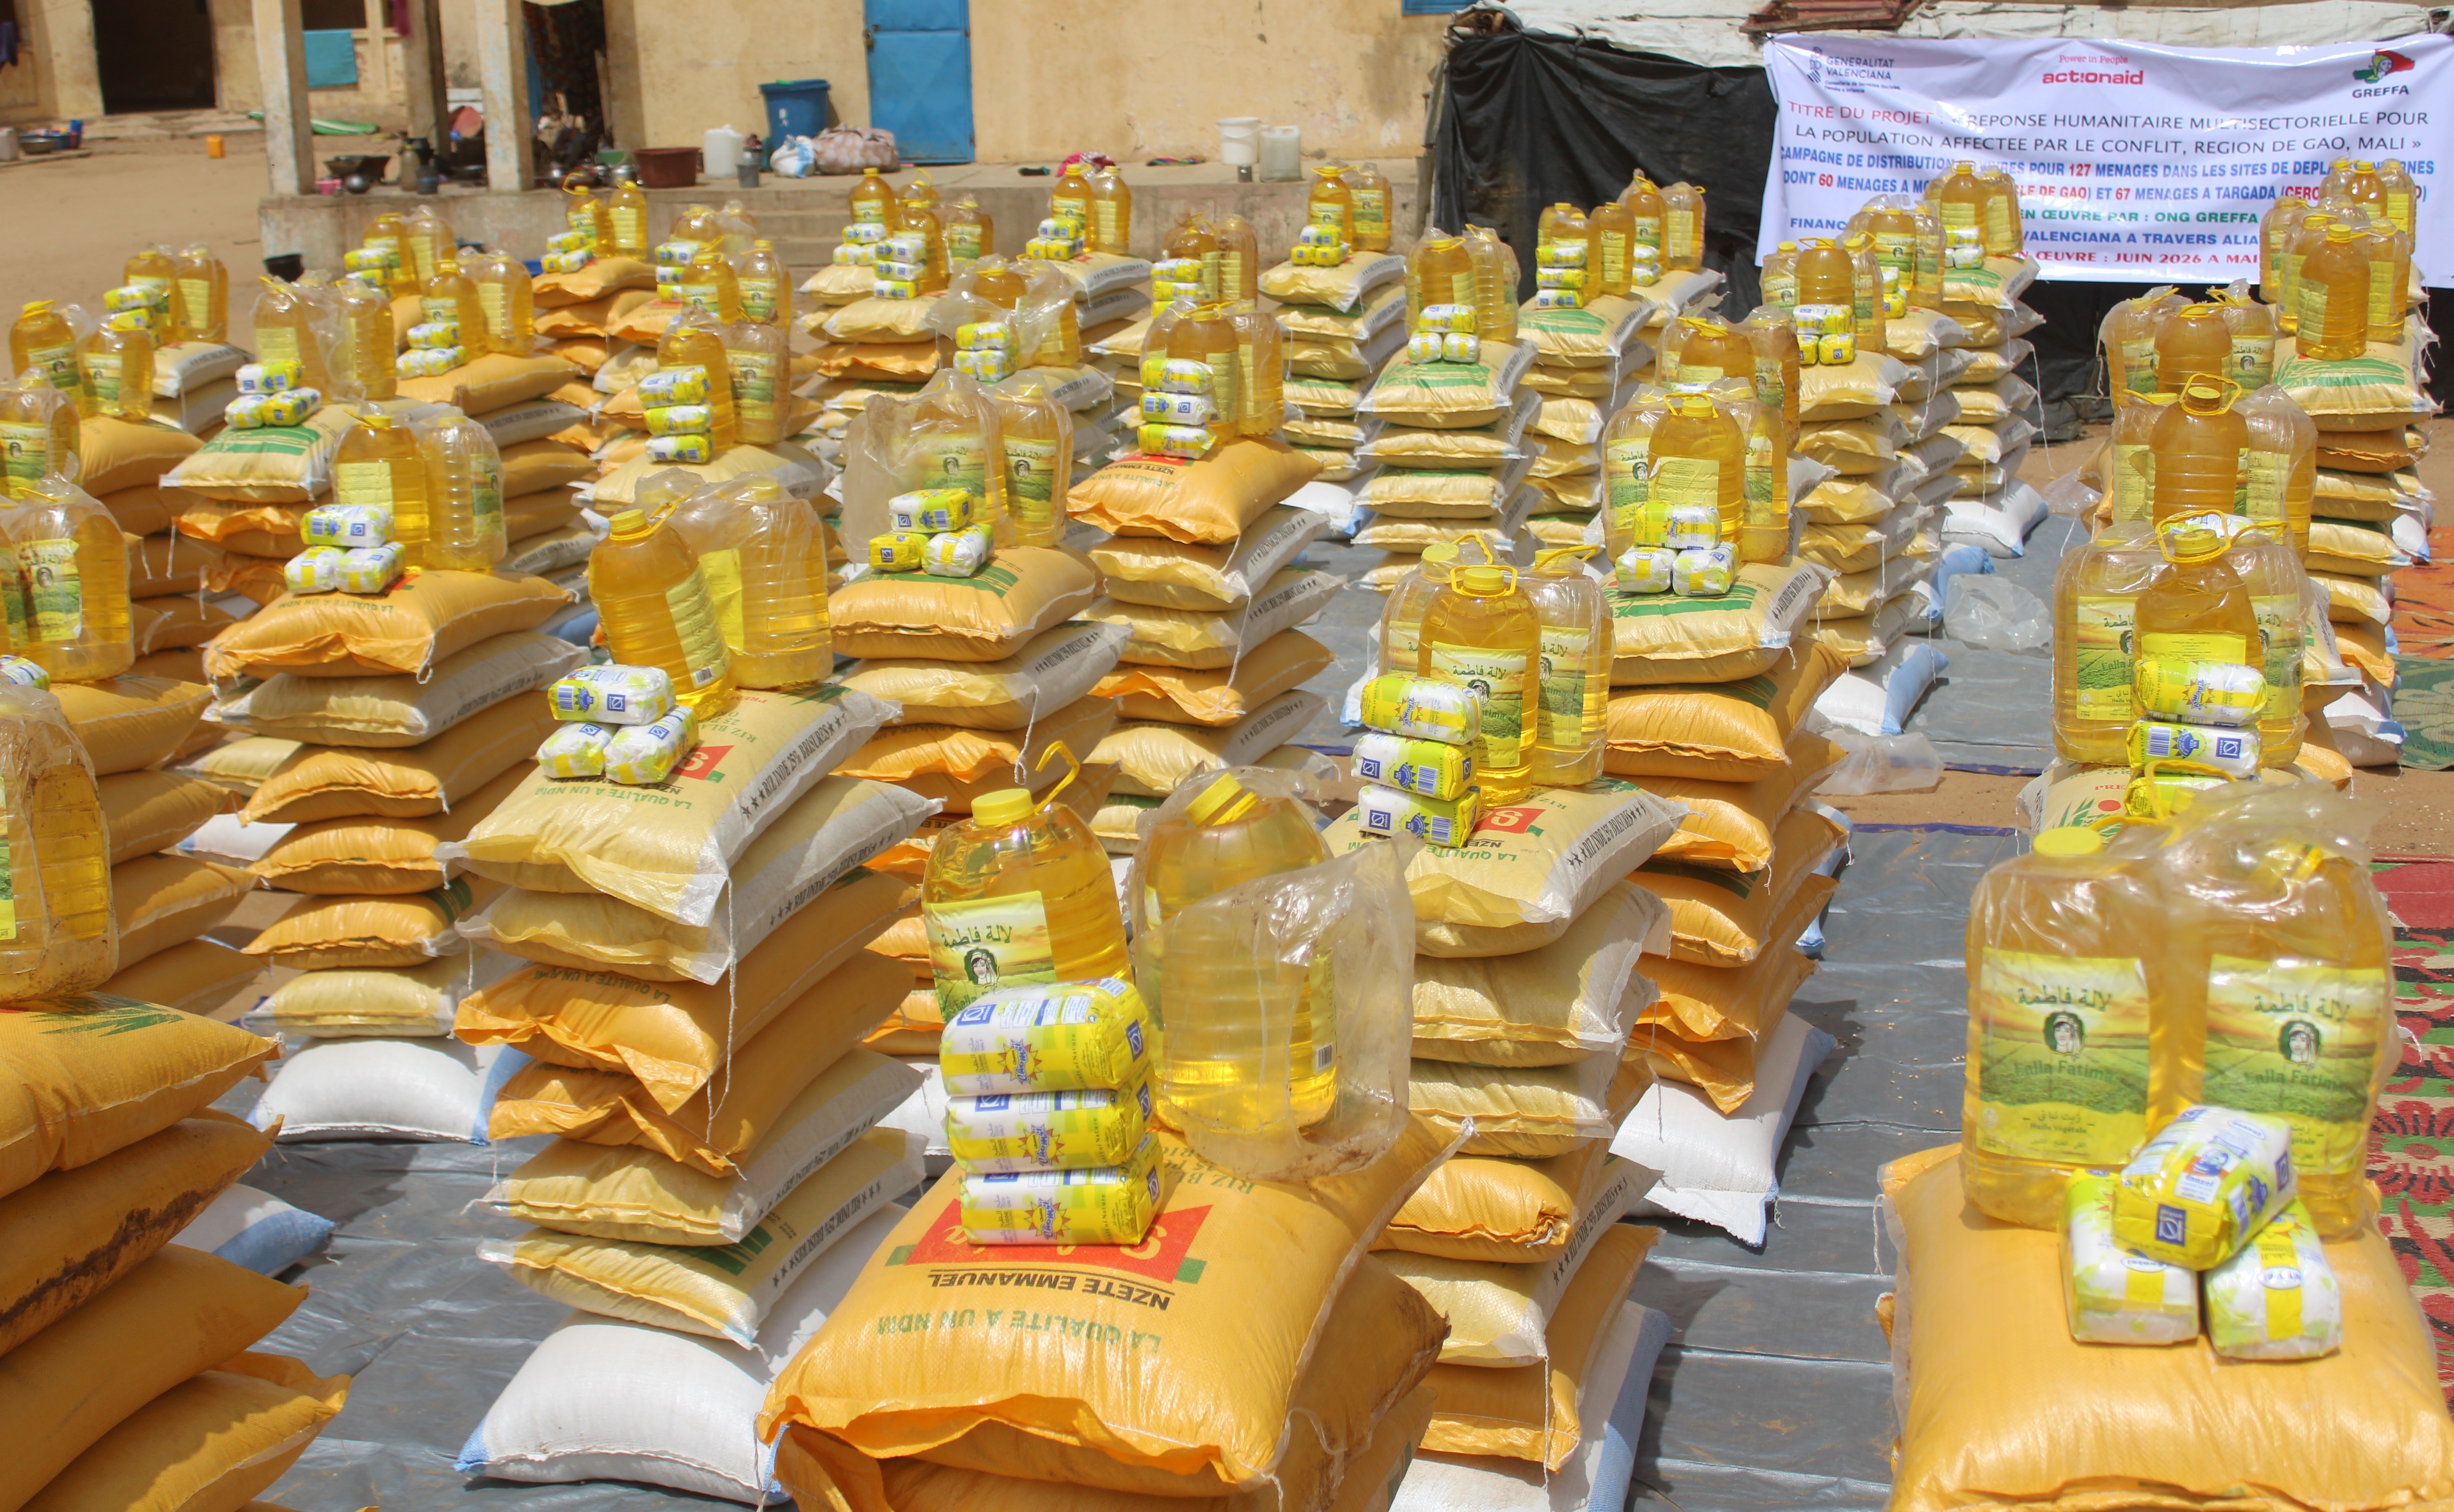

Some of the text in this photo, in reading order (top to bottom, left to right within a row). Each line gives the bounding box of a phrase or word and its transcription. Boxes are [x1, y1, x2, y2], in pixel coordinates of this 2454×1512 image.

[1827, 56, 1894, 68] GENERALITAT
[2059, 55, 2086, 63] Power
[2100, 56, 2128, 65] People
[1826, 67, 1891, 80] VALENCIANA
[2352, 85, 2410, 98] GREFFA
[1787, 101, 1834, 119] TITRE
[1840, 106, 1865, 119] DU
[1872, 110, 1934, 125] PROJET
[1969, 114, 2047, 127] REPONSE
[2054, 114, 2183, 129] HUMANITAIRE
[2376, 112, 2429, 125] POUR
[1796, 125, 1816, 139] LA
[1823, 130, 1933, 146] POPULATION
[1940, 137, 2027, 151] AFFECTEE
[2034, 139, 2068, 152] PAR
[2076, 140, 2094, 152] LE
[2102, 140, 2186, 155] CONFLIT,
[2194, 141, 2265, 154] REGION
[2272, 140, 2296, 152] DE
[2303, 137, 2350, 151] GAO,
[2358, 138, 2404, 150] MALI
[1781, 146, 2289, 177] CAMPAGNE DE DISTRIBUTION POUR 127 MENAGES DANS LES SITES DE
[1784, 170, 1816, 184] DONT
[1819, 174, 1833, 187] 60
[1837, 176, 1897, 192] MENAGES
[1901, 180, 1909, 193] A
[2039, 186, 2056, 197] DE
[2060, 186, 2091, 200] GAO)
[2096, 188, 2112, 200] ET
[2115, 187, 2131, 200] 67
[2135, 188, 2198, 200] MENAGES
[2203, 188, 2211, 200] A
[2216, 186, 2276, 200] TARGADA
[2042, 210, 2101, 221] ŒUVRE
[2108, 212, 2138, 222] PAR
[2155, 212, 2189, 222] ONG
[2196, 211, 2259, 223] GREFFA
[2126, 233, 2217, 245] A TRAVERS
[2036, 251, 2096, 262] ŒUVRE
[2115, 252, 2152, 263] JUIN
[2160, 253, 2202, 264] 2026
[2208, 253, 2220, 264] A
[278, 600, 301, 609] NDM
[333, 599, 378, 610] QUALITE
[381, 604, 393, 612] LA
[1551, 646, 1568, 657] لالة
[1452, 664, 1507, 680] لالة فاطمة
[2101, 660, 2126, 671] Lalla
[2191, 680, 2205, 710] Chemsi
[1402, 696, 1416, 726] Chemsi
[730, 728, 757, 743] RIZ
[762, 725, 831, 798] RIZ INDE 25% BRISURES
[568, 786, 591, 796] UN
[597, 787, 605, 797] A
[607, 788, 669, 805] QUALITE
[674, 799, 692, 810] LA
[1539, 796, 1568, 811] RIZ
[1582, 809, 1634, 859] RIZ INDE BRISURES
[1497, 851, 1518, 862] LA
[793, 891, 807, 910] RIZ
[806, 876, 827, 899] INDE
[942, 924, 1012, 949] لالة فاطمة
[561, 970, 672, 1004] LA QUALITE A UN
[2018, 985, 2112, 1012] لالة فاطمة
[2254, 992, 2349, 1022] لالة فاطمة
[982, 1005, 991, 1021] enasel
[970, 1054, 980, 1073] الطبخ
[1009, 1040, 1028, 1082] Chemsi
[2014, 1059, 2115, 1083] Lalla Fatima
[2245, 1068, 2286, 1084] Lalla
[1092, 1118, 1101, 1143] Nature
[2030, 1122, 2088, 1134] Huile Végétale
[990, 1139, 1000, 1157] الطبخ
[1030, 1124, 1050, 1165] Chemsi
[1210, 1174, 1256, 1195] RIZ
[996, 1211, 1006, 1228] الطبخ
[1038, 1198, 1056, 1239] Chemsi
[1568, 1186, 1616, 1262] RIZ INDE BRISURES
[794, 1227, 824, 1266] BRISURES
[928, 1273, 1171, 1312] NZETE EMMANUEL
[877, 1309, 1162, 1353] LA QUALITE A UN NDM
